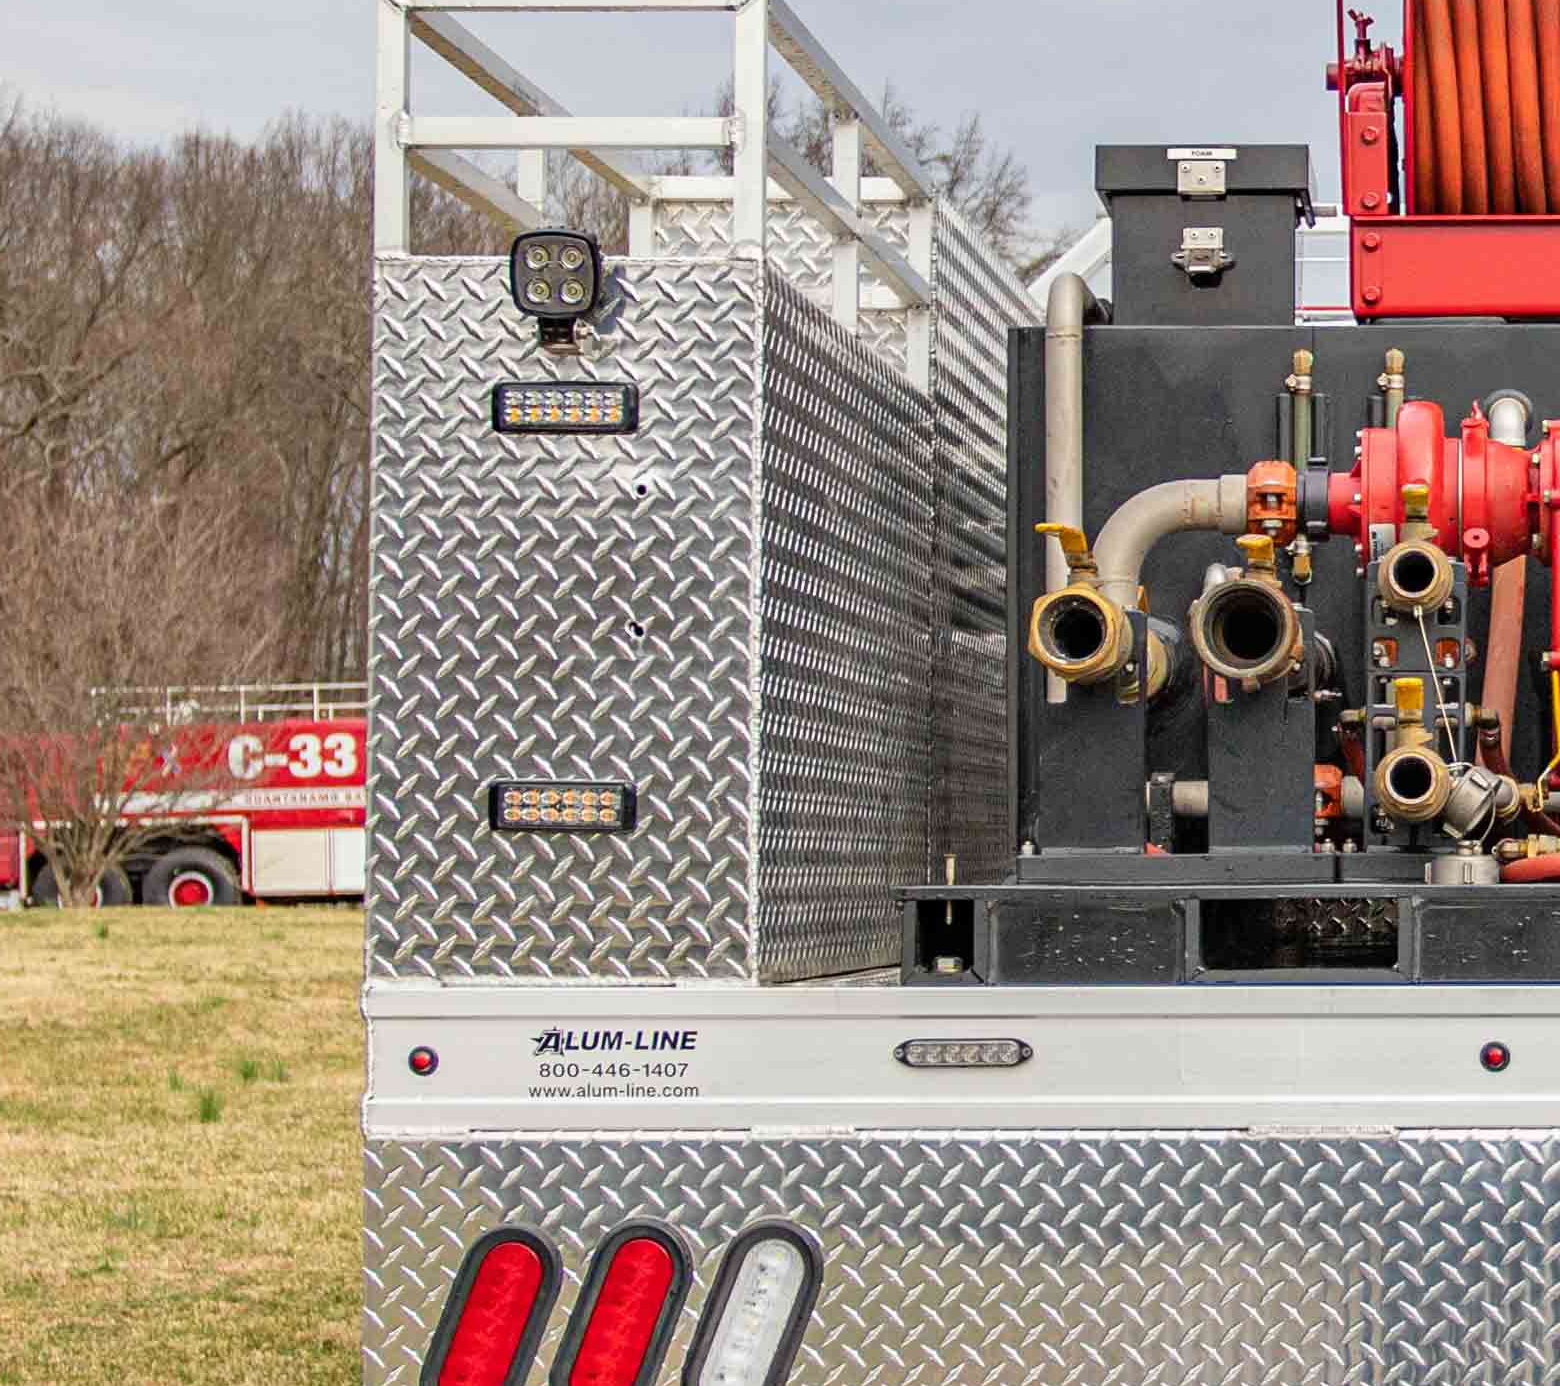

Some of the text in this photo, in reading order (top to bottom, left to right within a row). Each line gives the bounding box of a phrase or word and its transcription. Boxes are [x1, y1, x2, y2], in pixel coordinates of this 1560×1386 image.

[228, 732, 357, 780] C-33
[531, 1028, 698, 1055] ALUM-LINE
[539, 1062, 689, 1078] 800-446-1407
[528, 1082, 700, 1099] www.alum-line.com
